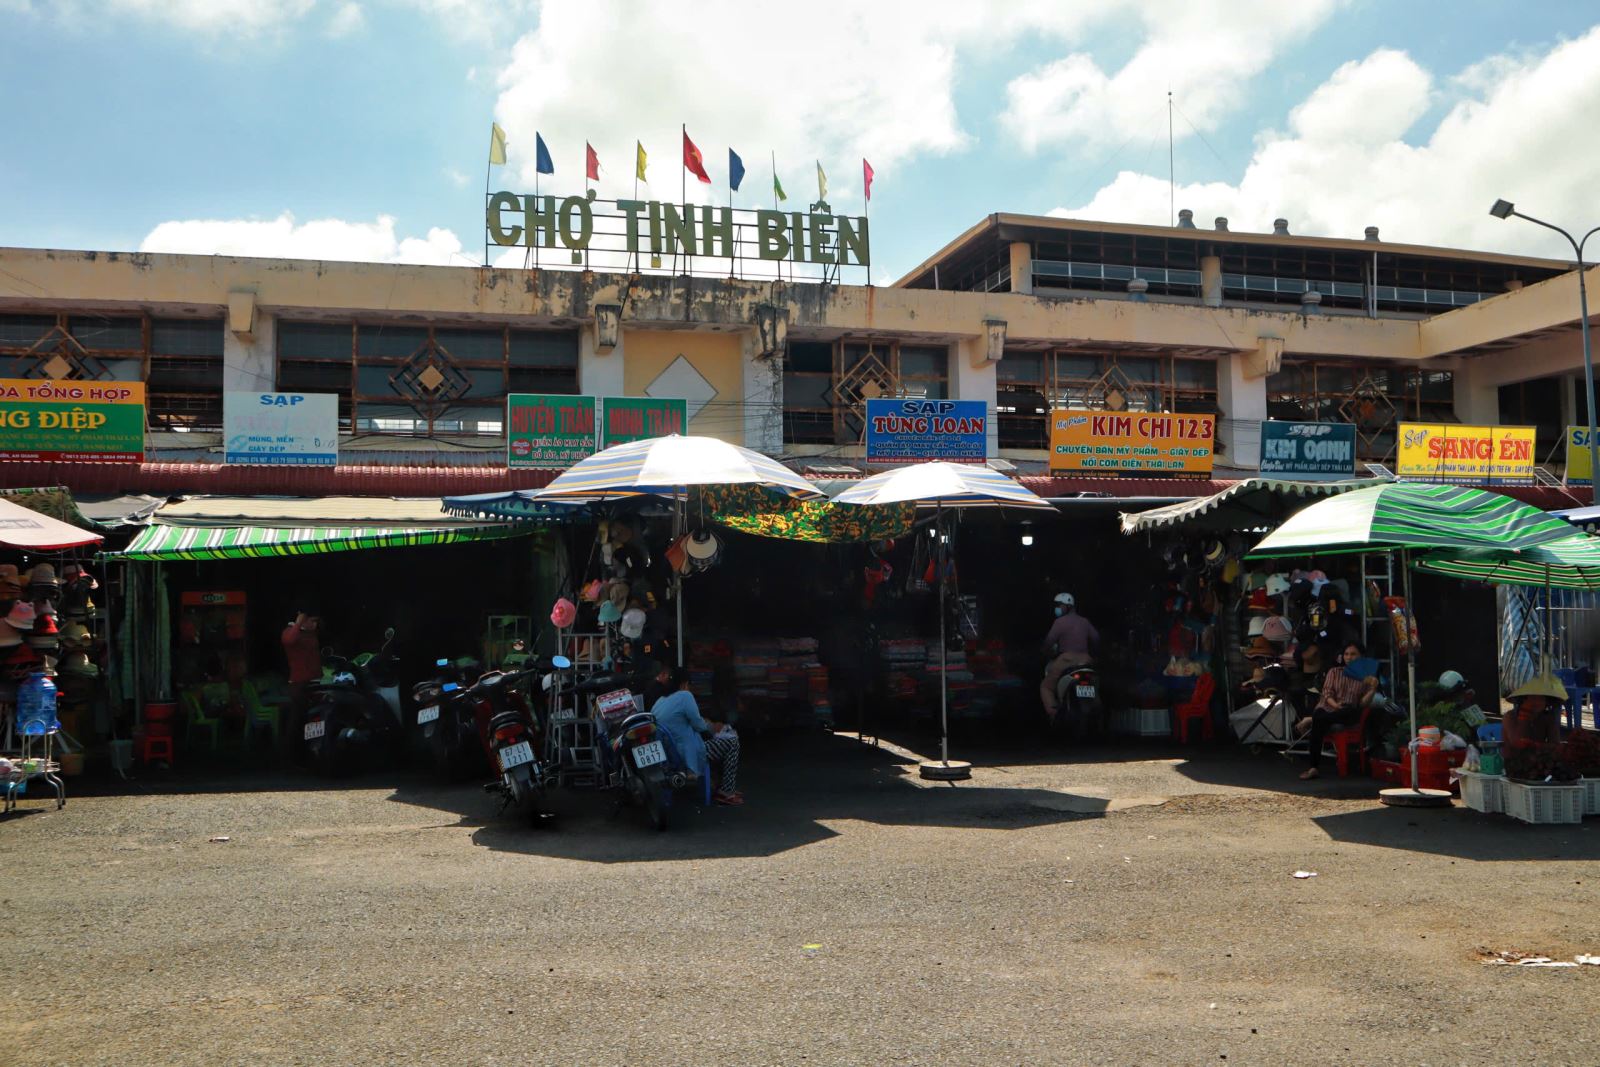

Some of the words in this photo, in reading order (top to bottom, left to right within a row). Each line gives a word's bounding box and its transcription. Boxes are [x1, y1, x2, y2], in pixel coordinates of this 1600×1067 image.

[488, 188, 596, 264] CHỢ
[617, 199, 733, 268] TỊNH
[758, 201, 869, 266] BIÊN
[27, 381, 83, 398] TỔNG
[90, 387, 131, 403] HỢP
[260, 394, 304, 407] SẠP
[38, 406, 106, 432] ĐIỆP
[902, 401, 955, 417] SẠP
[873, 412, 928, 434] TÙNG
[933, 416, 985, 434] LOAN
[1092, 415, 1133, 437] KIM
[1137, 416, 1173, 439] CHI
[1177, 418, 1214, 439] 123
[1056, 444, 1093, 454] CHUYÊN
[1265, 439, 1297, 459] KIM
[1428, 436, 1494, 460] SANG
[1167, 460, 1185, 469] LAN
[508, 752, 528, 765] 1211
[640, 752, 661, 765] 0817
